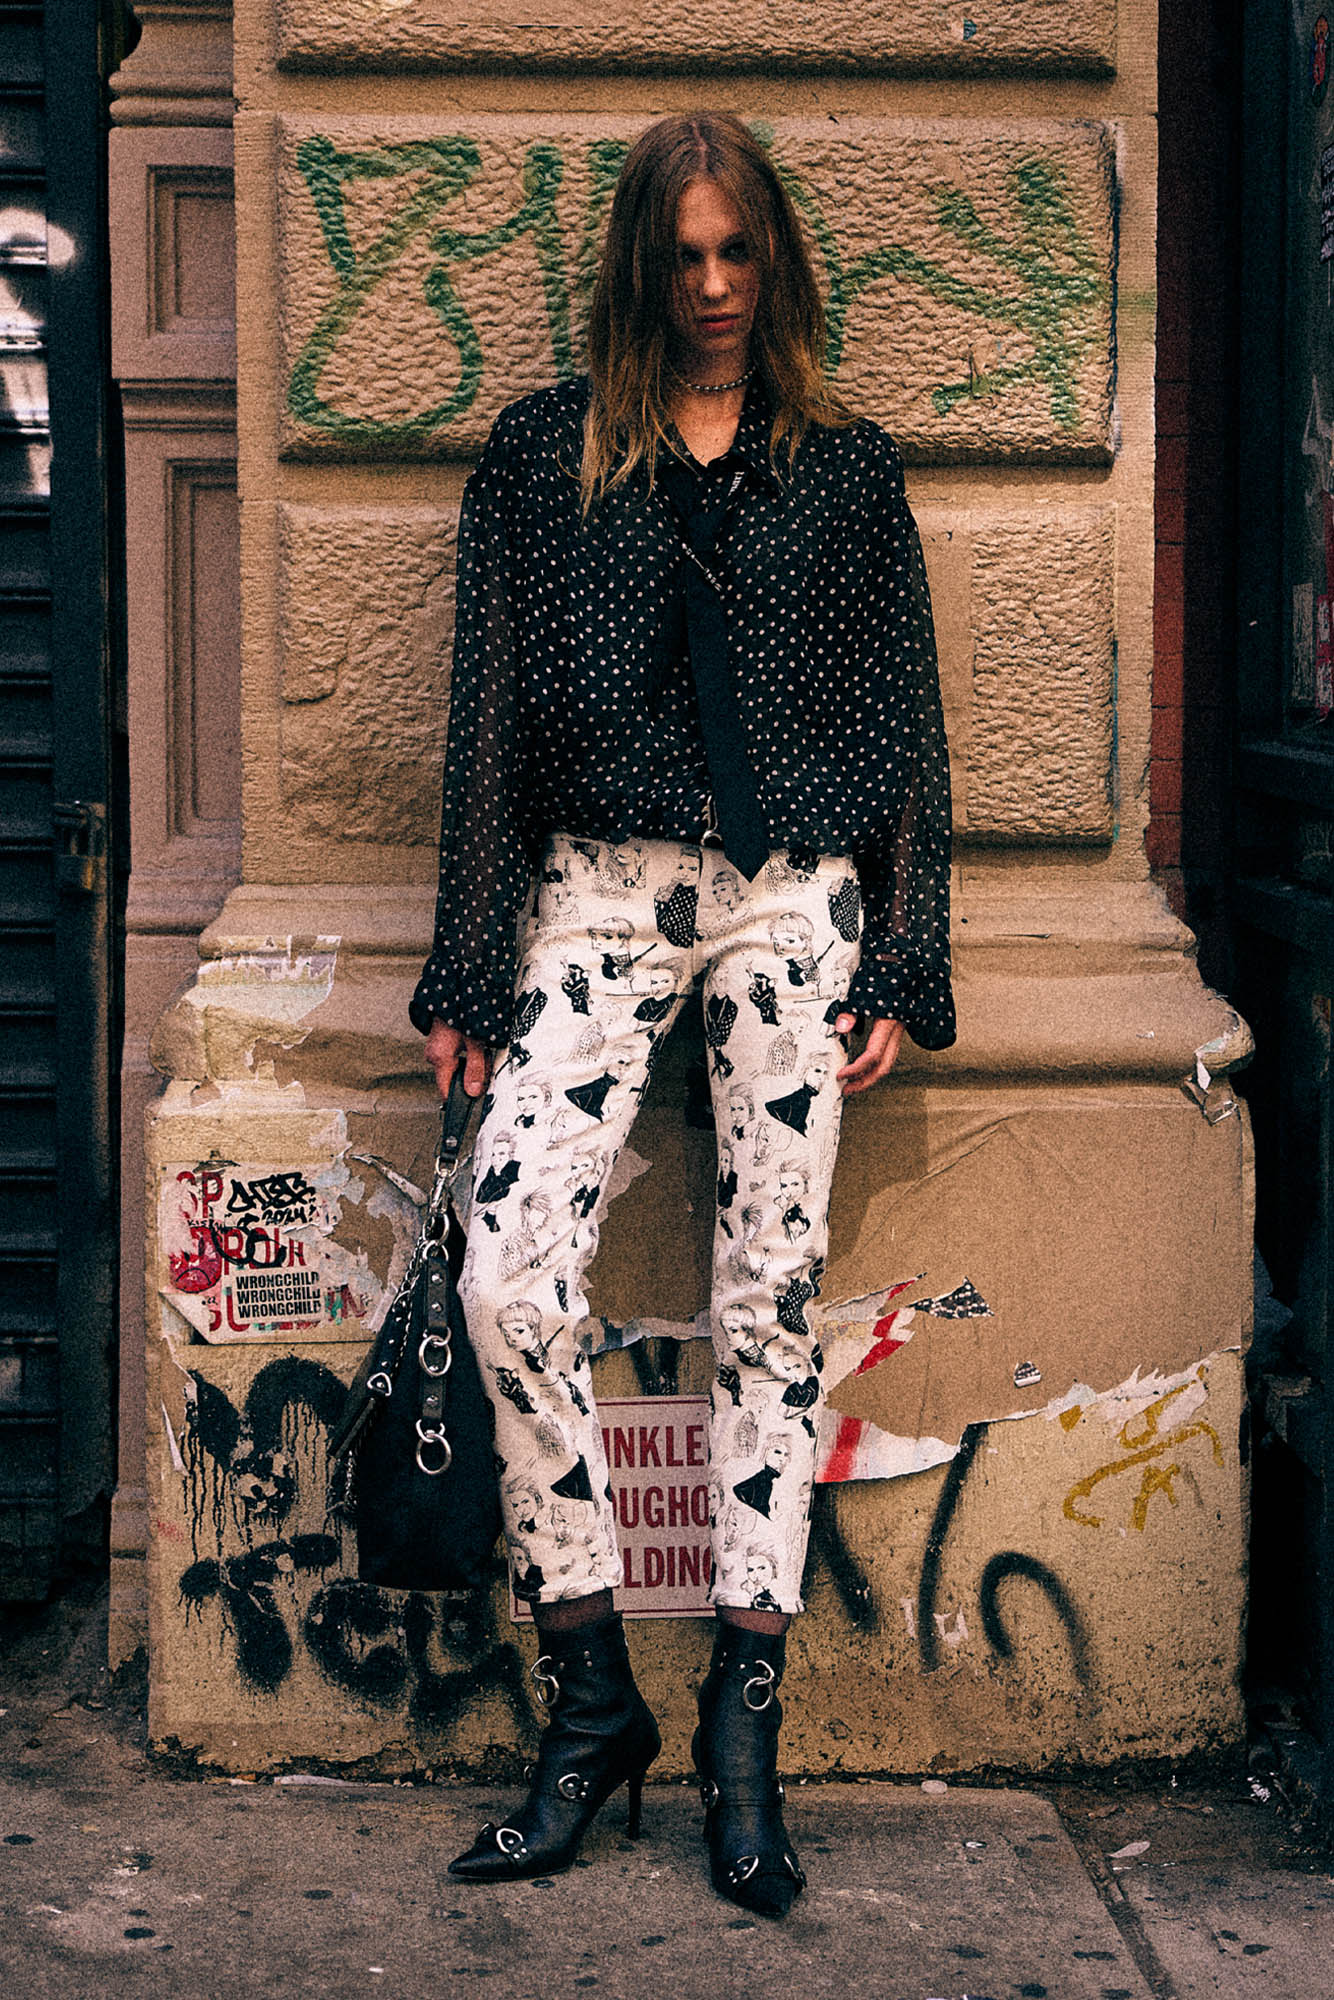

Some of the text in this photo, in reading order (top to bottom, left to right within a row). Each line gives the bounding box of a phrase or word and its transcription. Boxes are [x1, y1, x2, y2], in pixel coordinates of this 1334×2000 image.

[236, 1272, 320, 1290] WRONGCHILD
[238, 1301, 321, 1318] WRONGCHILD
[611, 1484, 710, 1529] UGHO
